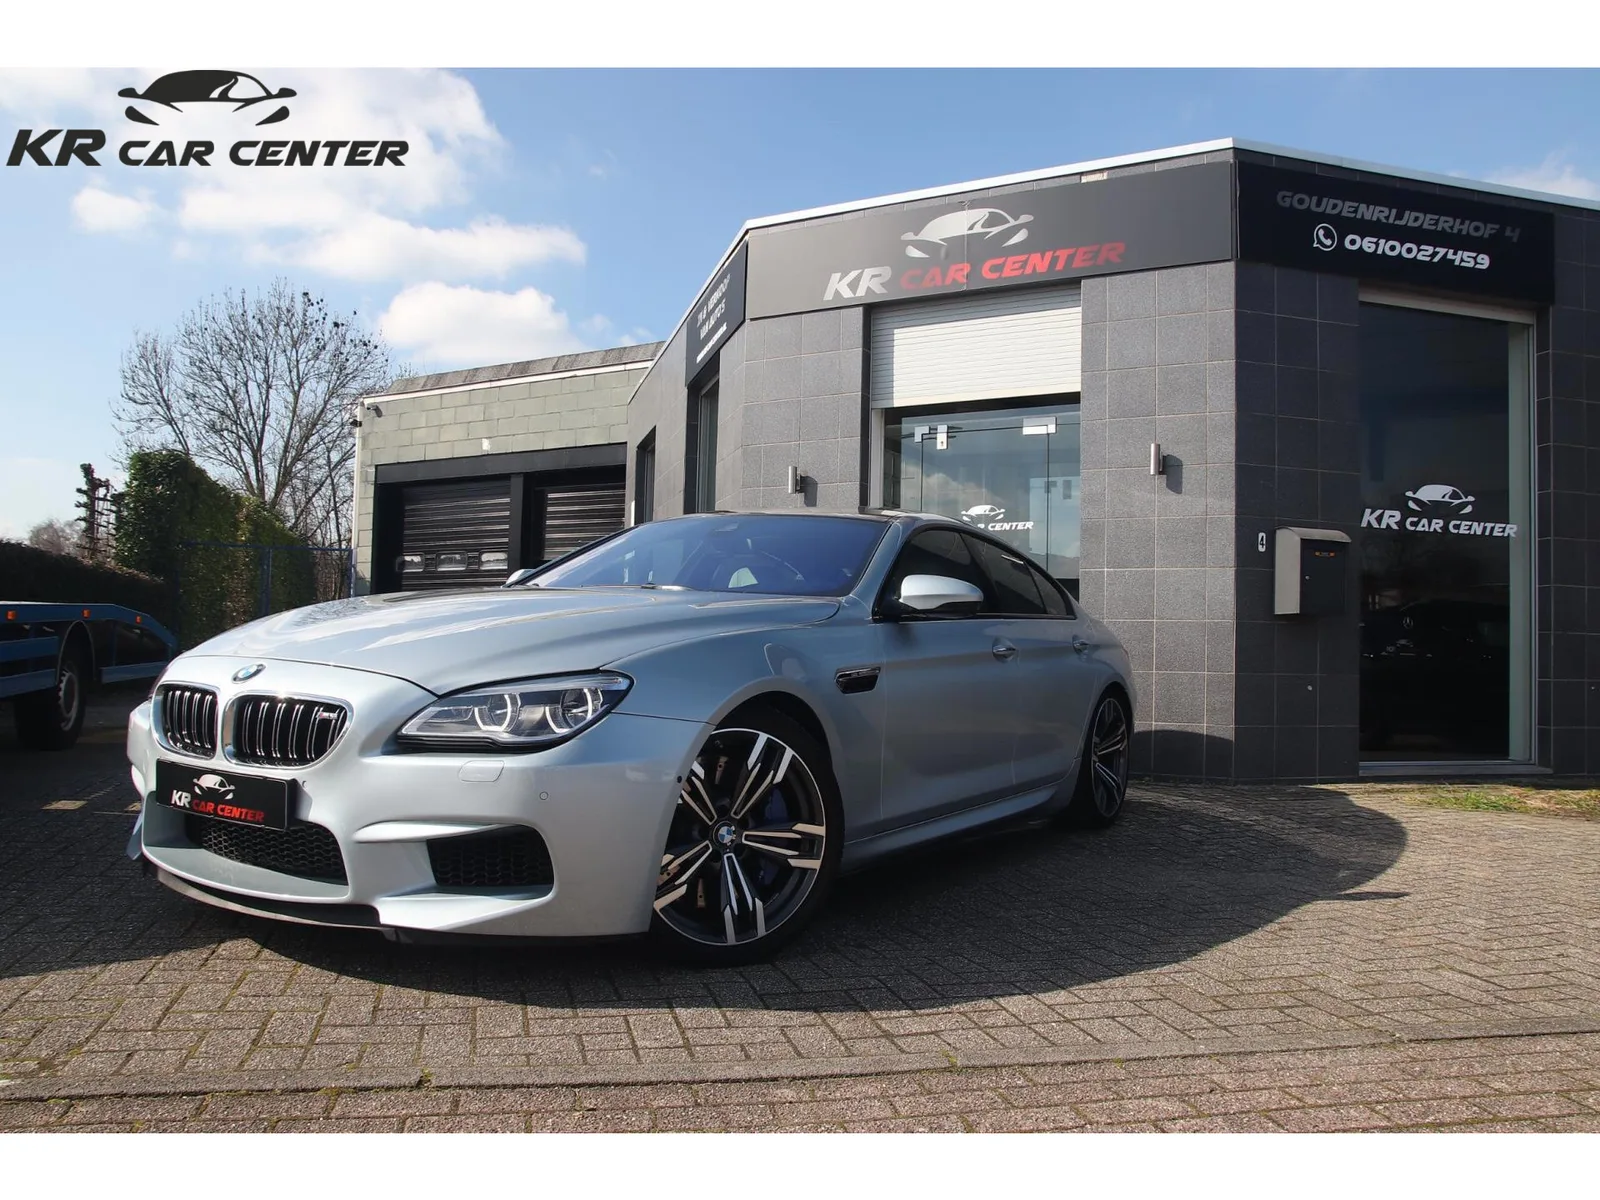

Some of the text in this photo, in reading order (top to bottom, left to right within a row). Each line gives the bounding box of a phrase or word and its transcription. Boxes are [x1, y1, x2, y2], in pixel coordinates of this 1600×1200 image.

[1276, 190, 1521, 243] GOUDENRIJDERHOF 4
[1344, 234, 1491, 270] 0610027459
[823, 242, 1126, 301] KR CAR CENTER
[988, 521, 1034, 531] CENTER
[1360, 508, 1518, 538] KR CAR CENTER
[1259, 535, 1266, 549] 4
[171, 789, 265, 823] KR CAR CENTER
